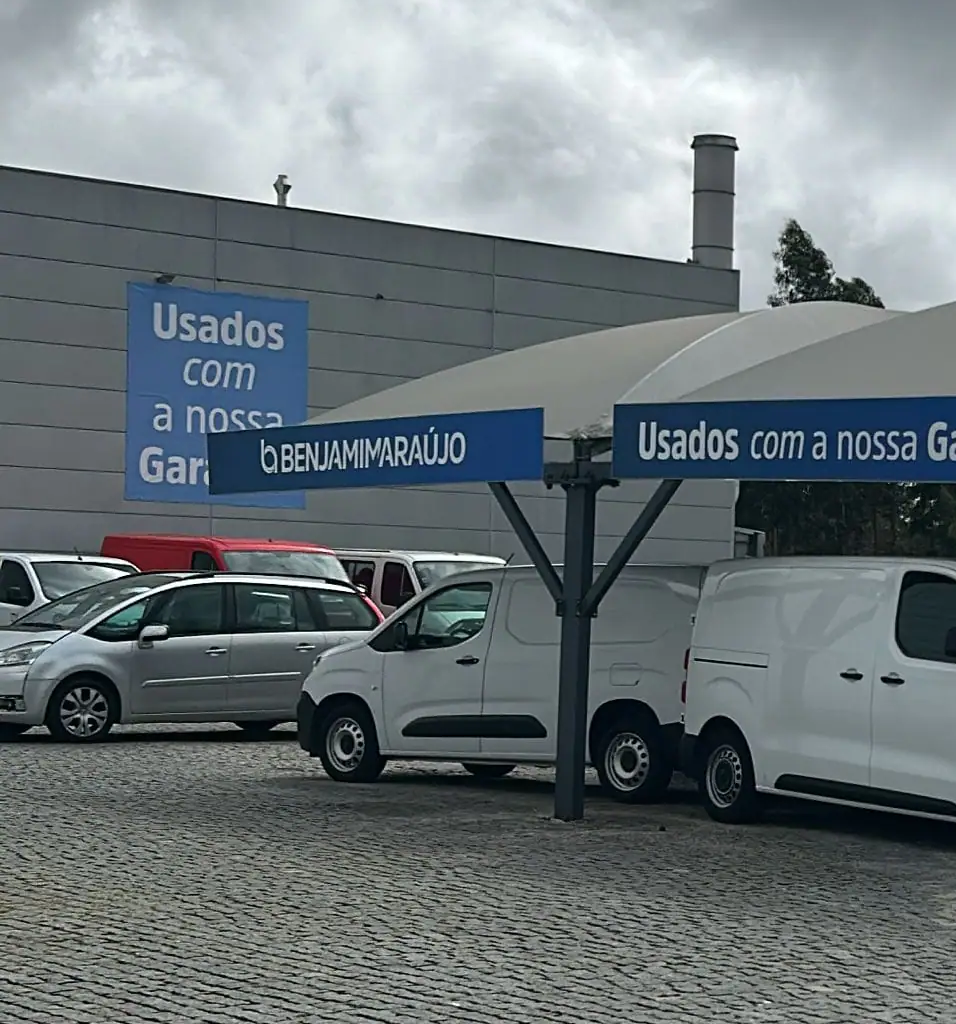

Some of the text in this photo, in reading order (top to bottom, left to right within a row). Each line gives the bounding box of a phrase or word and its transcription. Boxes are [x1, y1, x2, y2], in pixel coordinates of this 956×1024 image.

[153, 302, 285, 351] Usados
[183, 357, 256, 390] com
[153, 403, 173, 432] a
[638, 420, 740, 460] Usados
[750, 430, 805, 460] com
[812, 430, 828, 460] a
[837, 429, 918, 461] nossa
[139, 446, 209, 486] Gar
